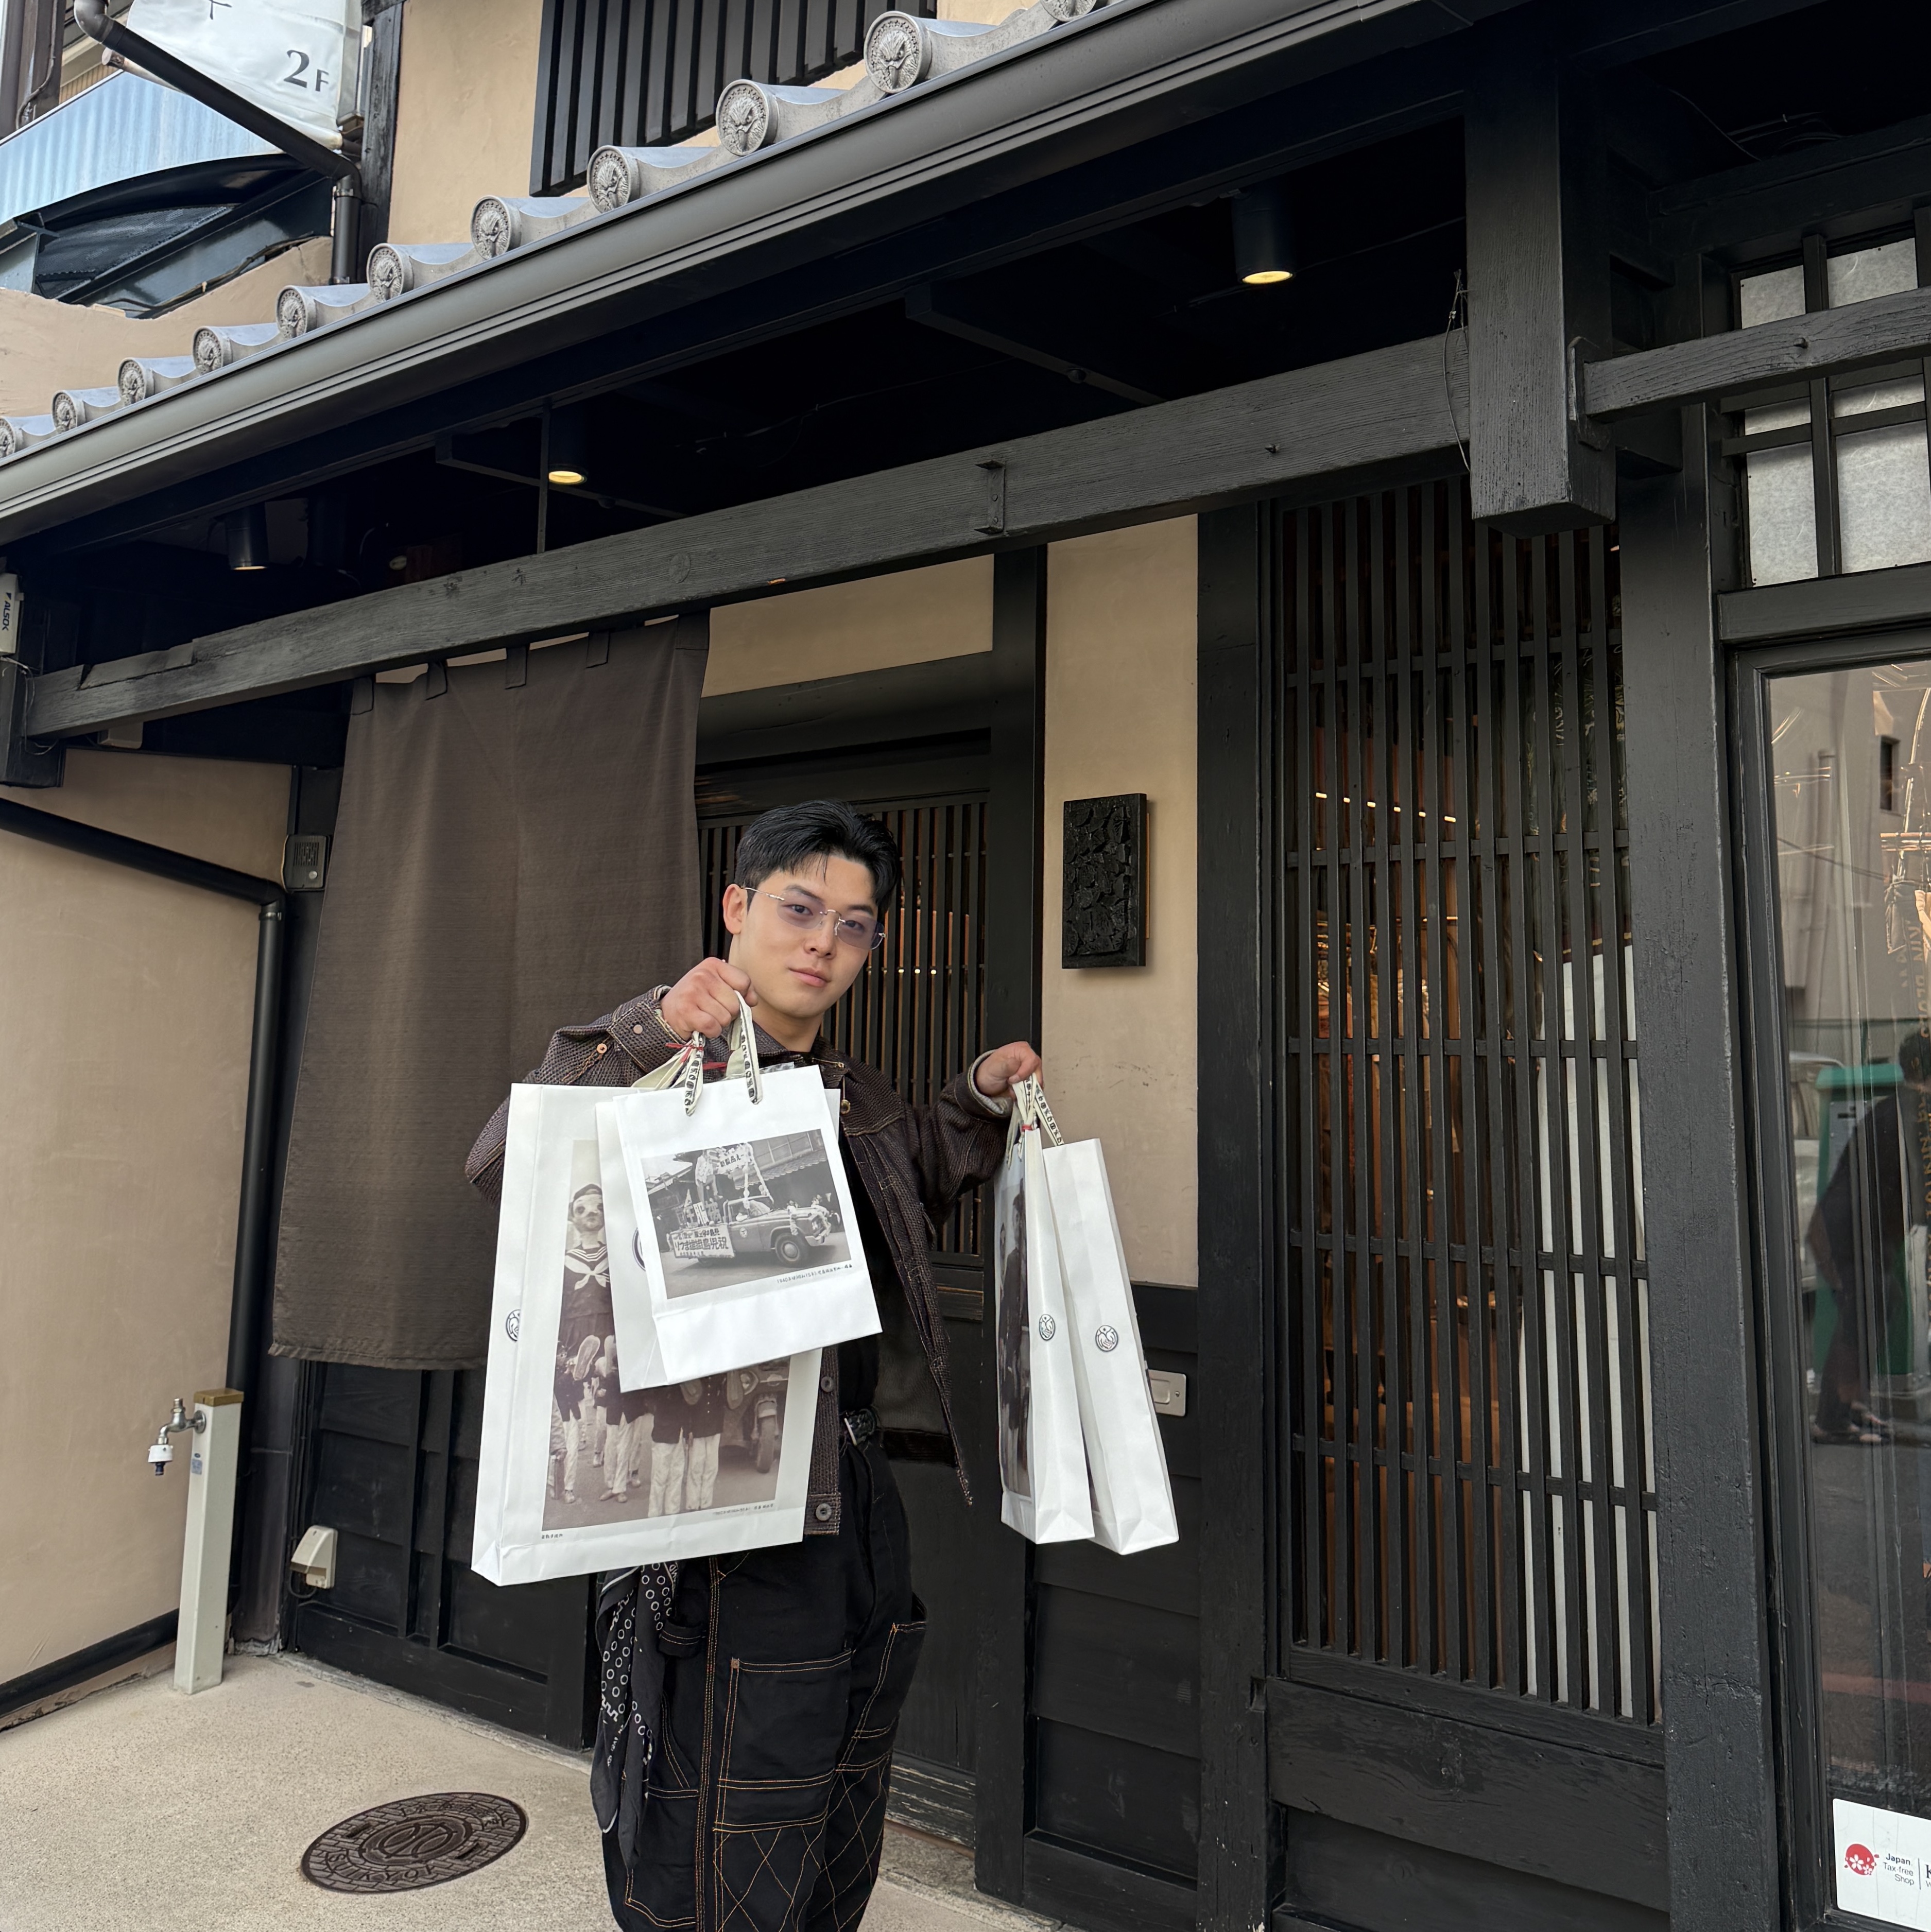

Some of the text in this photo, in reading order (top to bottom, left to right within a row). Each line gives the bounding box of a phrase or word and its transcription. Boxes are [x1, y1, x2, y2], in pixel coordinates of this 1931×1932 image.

[283, 49, 330, 92] 2F
[2, 600, 11, 631] ALSOK
[1883, 1862, 1913, 1876] Tax-free
[1894, 1874, 1915, 1886] Shop
